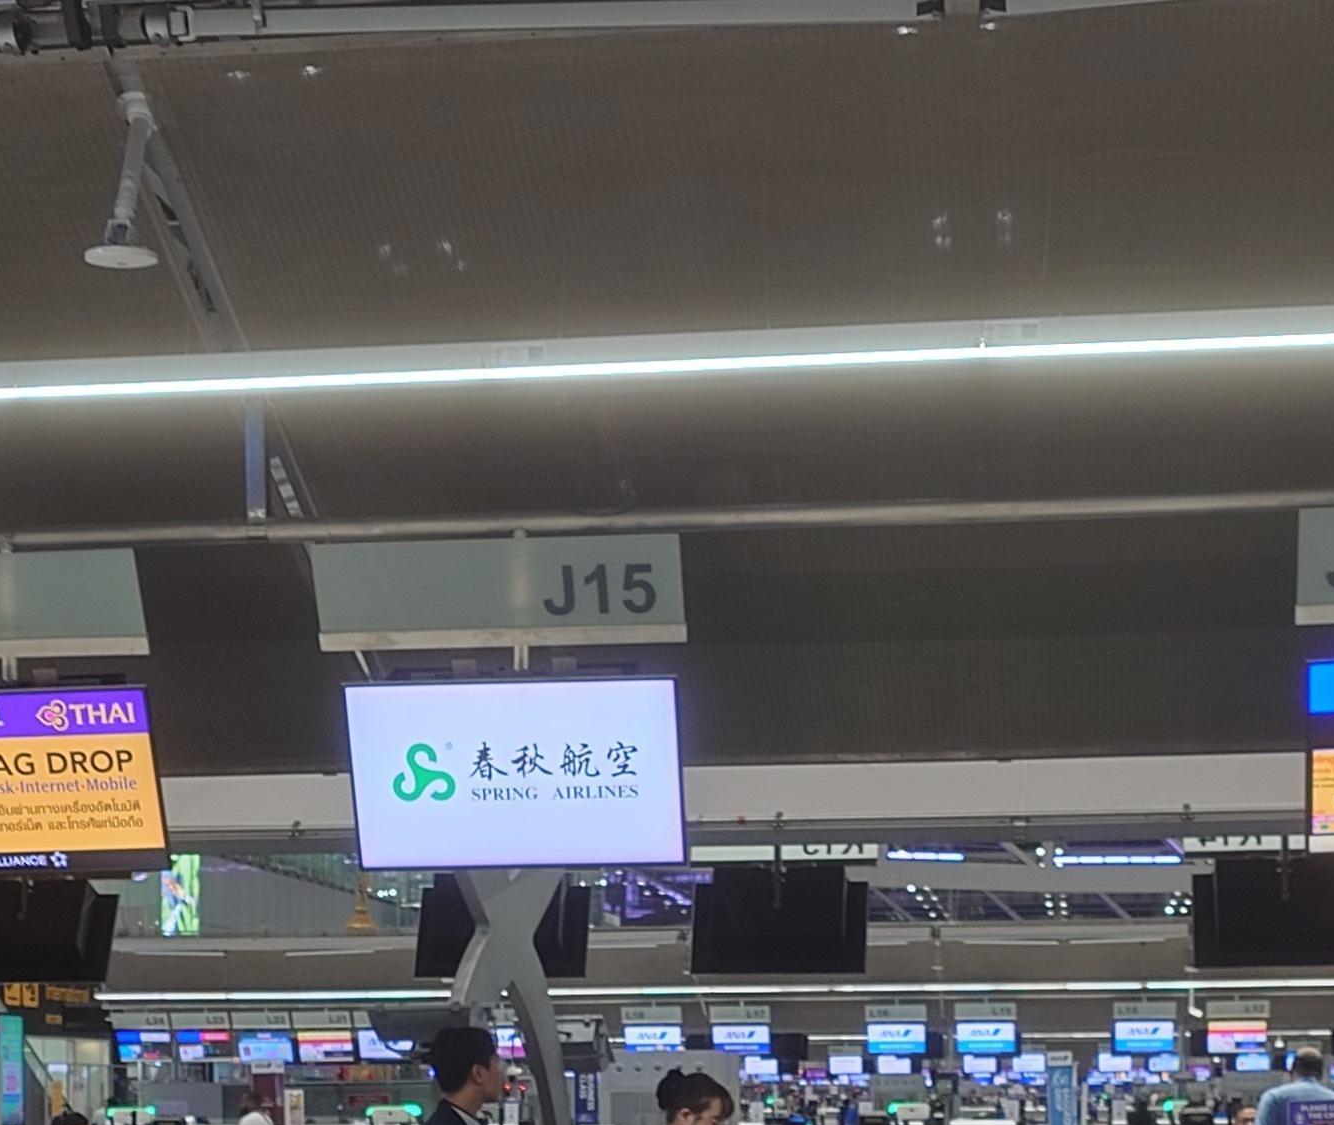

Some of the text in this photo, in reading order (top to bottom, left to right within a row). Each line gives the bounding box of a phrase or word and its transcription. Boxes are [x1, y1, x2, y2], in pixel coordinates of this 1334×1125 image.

[543, 563, 657, 616] J15
[67, 702, 136, 726] THAI
[47, 750, 134, 774] DROP
[468, 740, 640, 779] 春秋航空
[471, 783, 639, 801] SPRING AIRLINES
[1301, 1104, 1328, 1112] PLEASE
[1308, 1111, 1323, 1120] THE
